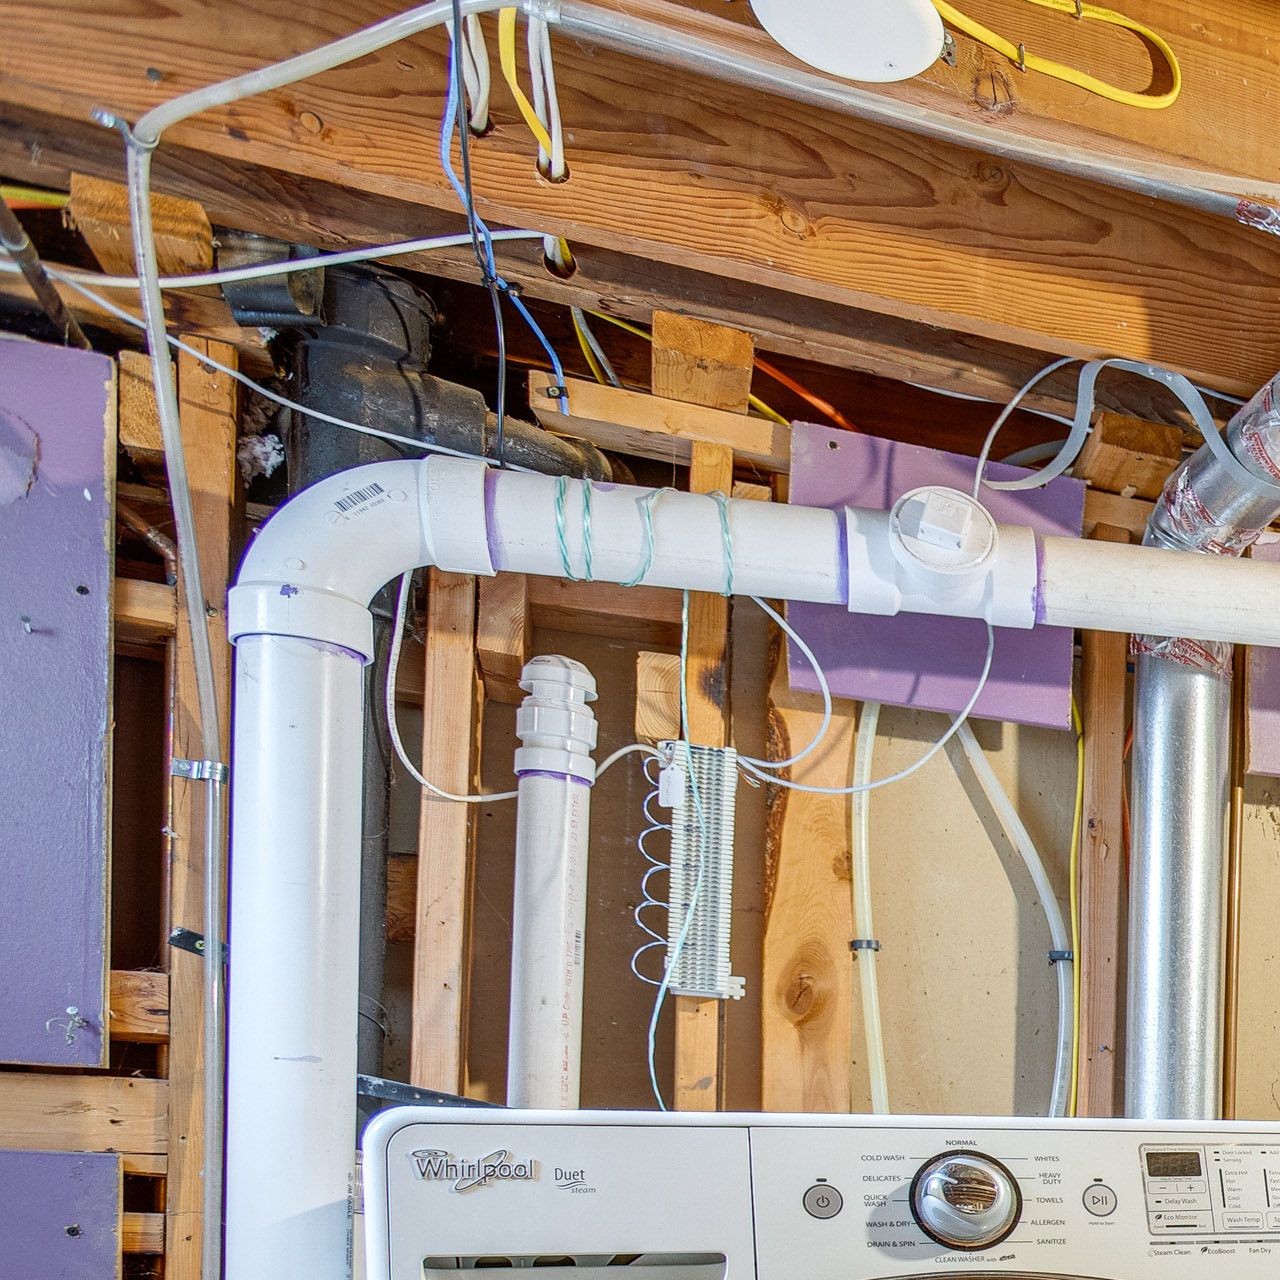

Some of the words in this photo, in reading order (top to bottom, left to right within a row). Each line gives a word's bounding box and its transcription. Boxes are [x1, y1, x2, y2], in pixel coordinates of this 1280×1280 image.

[945, 1139, 978, 1147] NORMAL
[861, 1154, 882, 1162] COLD
[883, 1154, 905, 1162] WASH
[414, 1154, 535, 1190] Whirlpool
[554, 1167, 586, 1181] Duet
[1038, 1172, 1061, 1180] HEAVY
[862, 1175, 901, 1183] DELICATES
[1042, 1178, 1062, 1186] DUTY
[570, 1186, 597, 1194] steam
[863, 1194, 888, 1202] QUICK
[865, 1220, 887, 1228] WASH
[888, 1220, 896, 1228] &
[896, 1220, 912, 1228] DRY
[1244, 1216, 1261, 1225] Temp
[867, 1240, 890, 1248] DRAIN
[890, 1240, 898, 1248] &
[898, 1240, 916, 1248] SPIN
[1036, 1238, 1067, 1246] SANITIZE
[1153, 1249, 1173, 1257] Steam
[1174, 1248, 1191, 1256] Clean
[1207, 1247, 1236, 1255] EcoBoost
[1249, 1246, 1259, 1254] Fan
[1259, 1246, 1272, 1256] Dry
[934, 1256, 957, 1264] CLEAN
[957, 1255, 985, 1263] WASHER
